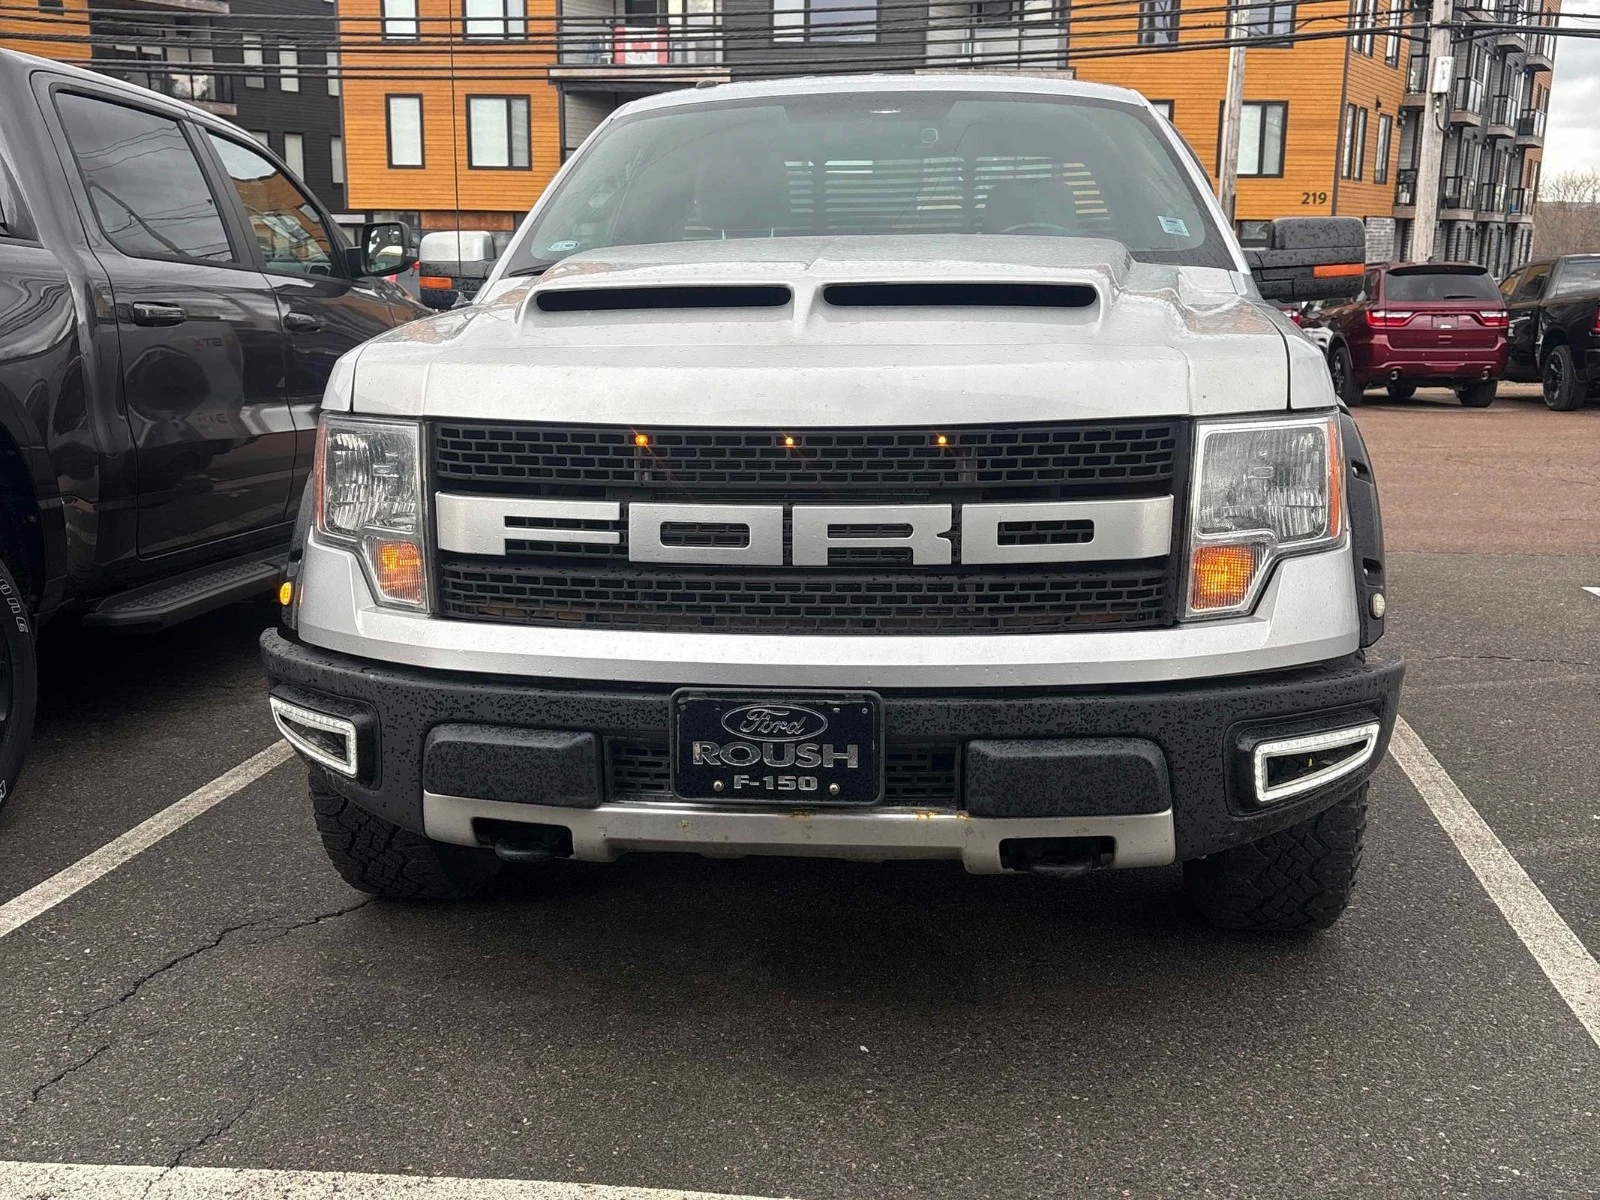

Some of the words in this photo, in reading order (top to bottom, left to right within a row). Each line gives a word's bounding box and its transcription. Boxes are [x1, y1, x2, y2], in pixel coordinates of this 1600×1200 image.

[1301, 192, 1327, 205] 219
[436, 491, 1174, 567] FORD
[739, 707, 807, 735] Ford
[692, 740, 859, 768] ROUSH
[733, 774, 819, 791] F-150
